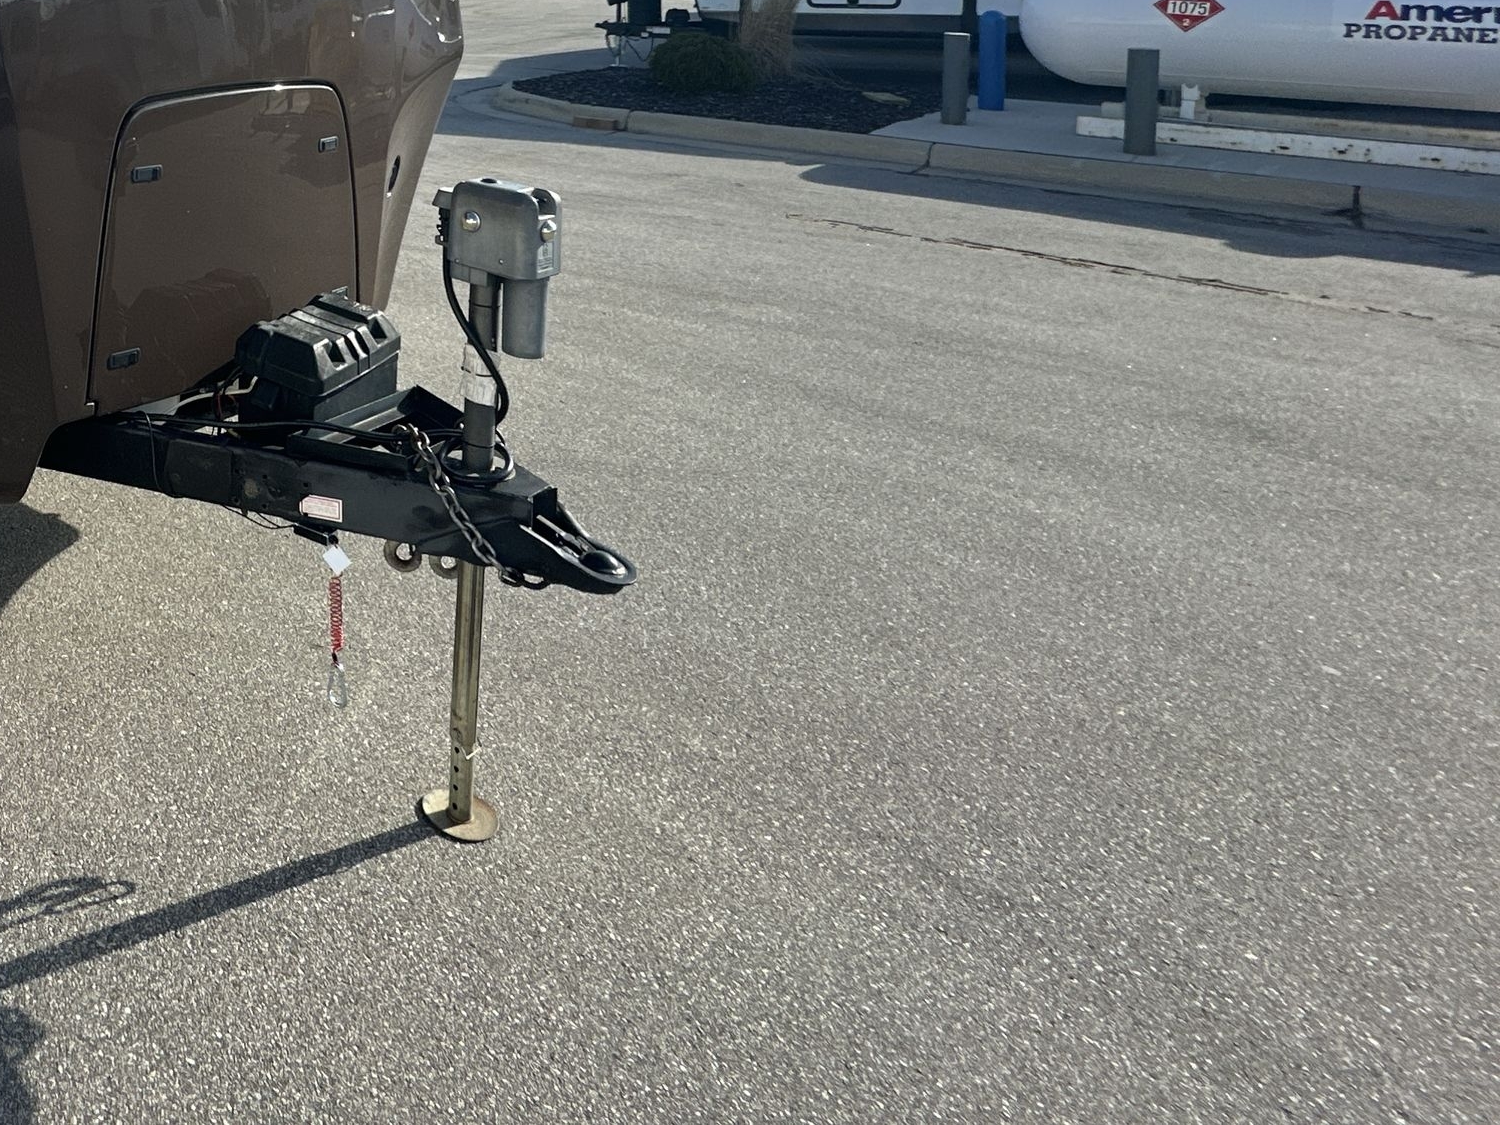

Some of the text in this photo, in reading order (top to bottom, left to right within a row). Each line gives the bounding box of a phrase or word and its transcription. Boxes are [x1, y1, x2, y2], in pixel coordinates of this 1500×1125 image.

[1171, 1, 1207, 15] 1075
[1182, 18, 1190, 27] 2
[1343, 23, 1498, 44] PROPANE
